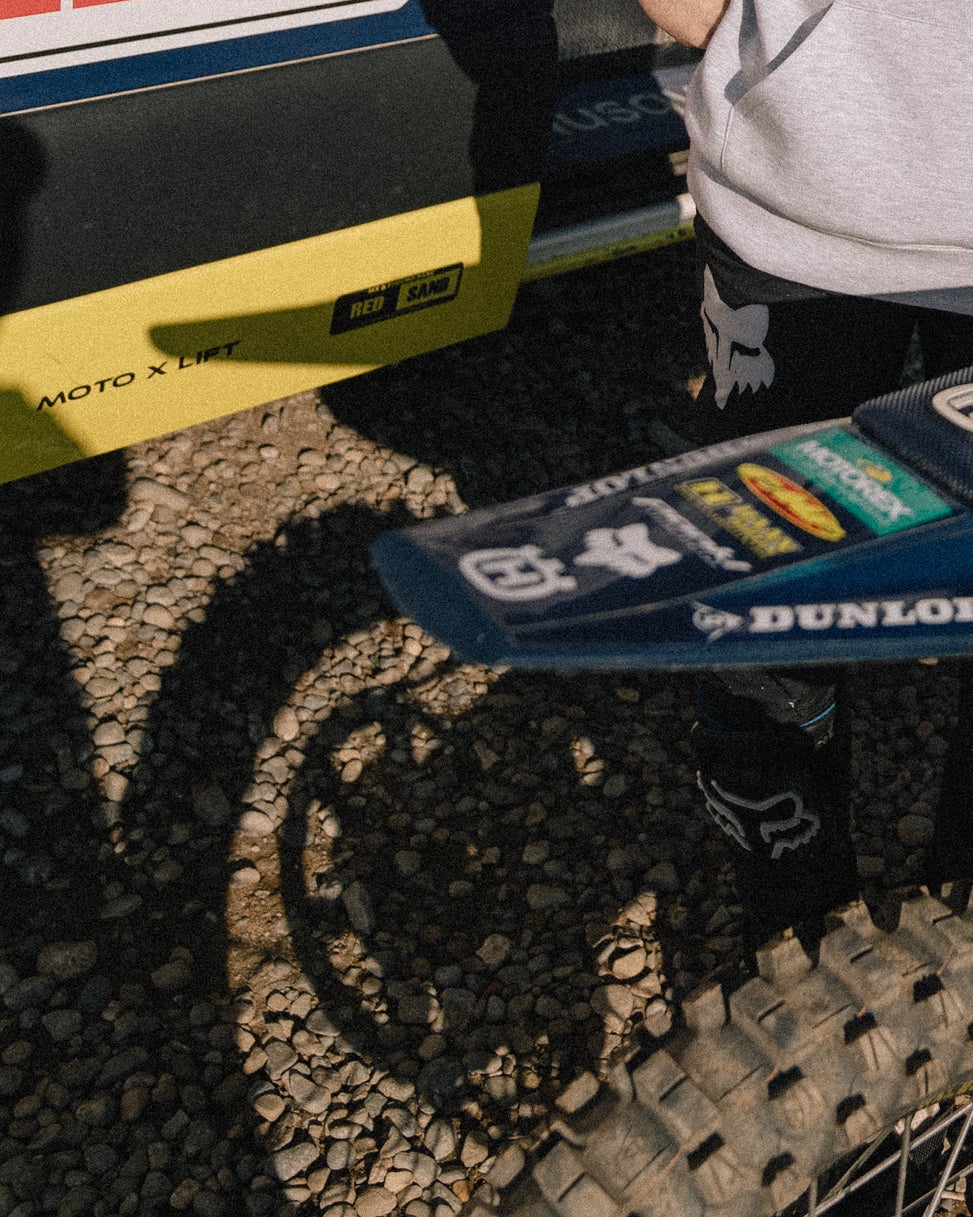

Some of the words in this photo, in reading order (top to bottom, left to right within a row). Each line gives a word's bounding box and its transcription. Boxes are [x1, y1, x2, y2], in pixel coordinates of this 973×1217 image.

[350, 296, 385, 319] RED
[406, 277, 450, 302] SAND
[37, 372, 135, 412] MOTO
[147, 361, 168, 379] X
[178, 340, 242, 370] LIFT
